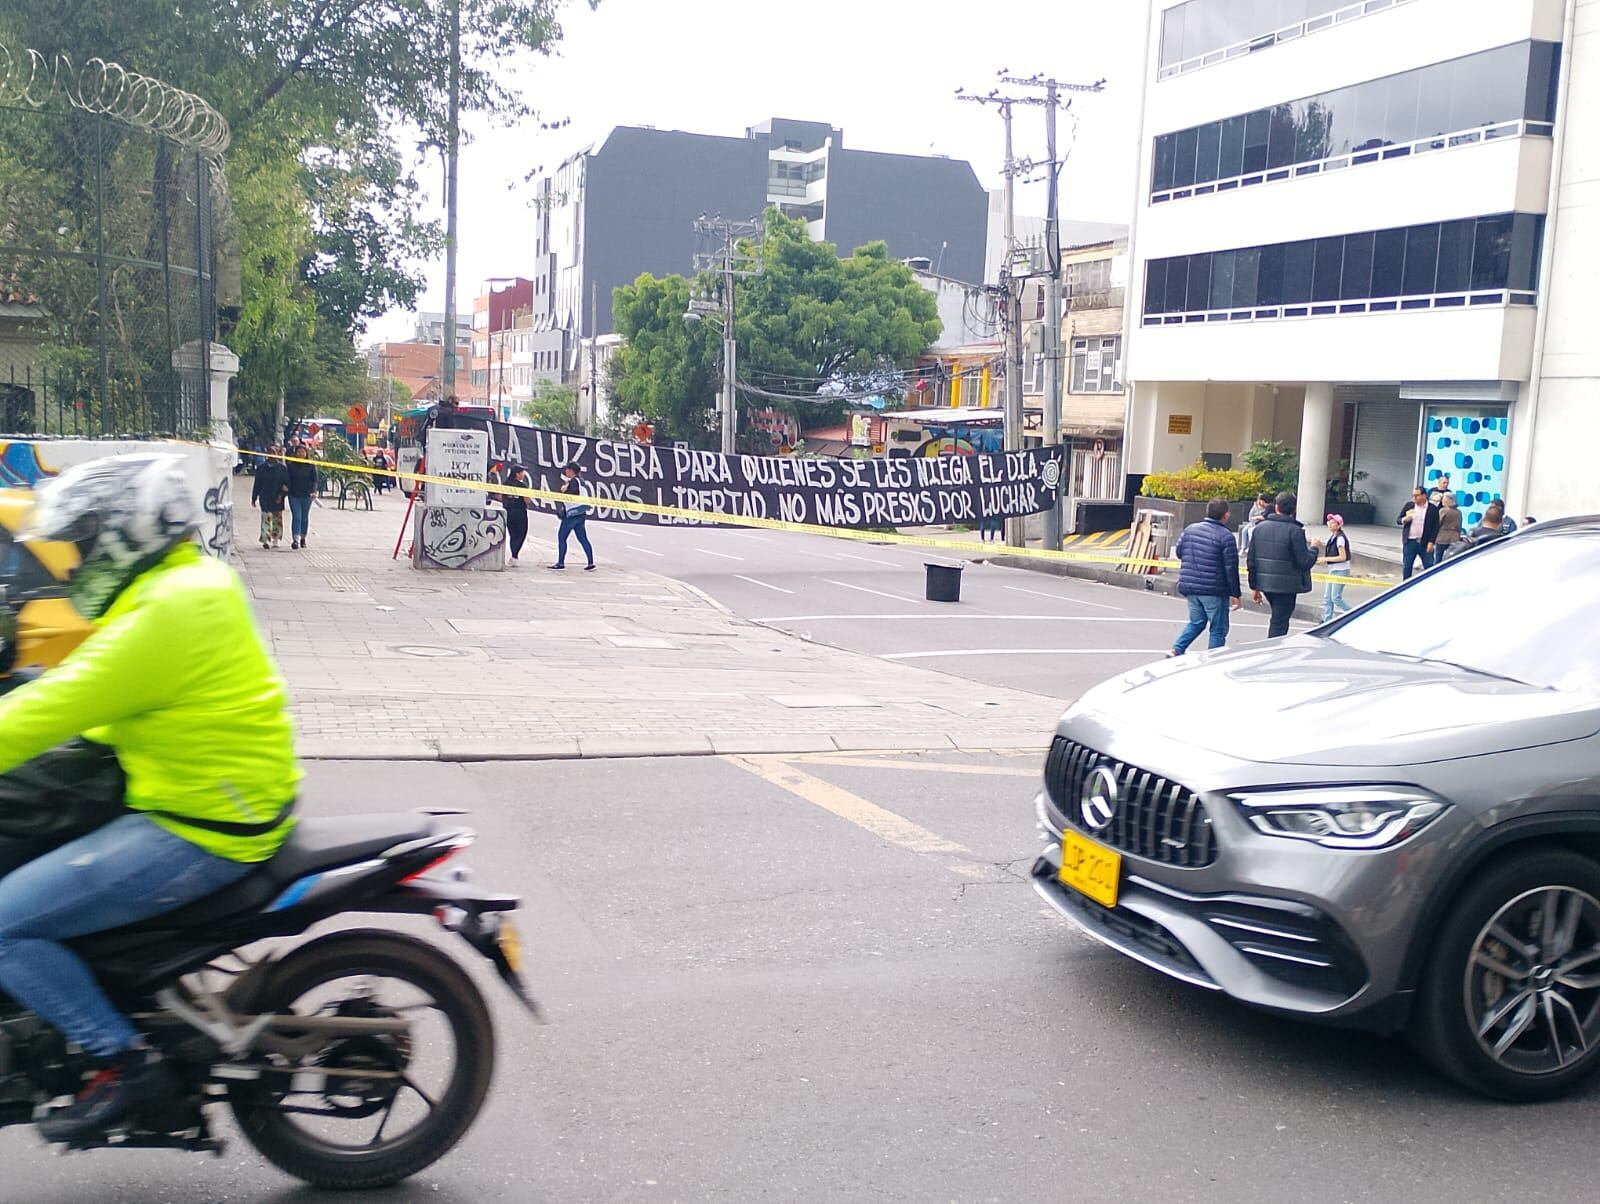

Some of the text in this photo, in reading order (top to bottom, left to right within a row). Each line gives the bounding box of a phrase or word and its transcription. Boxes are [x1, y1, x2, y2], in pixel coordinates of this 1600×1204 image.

[486, 421, 522, 464] LA
[536, 430, 588, 473] LUZ
[595, 440, 664, 480] SERA
[673, 448, 733, 484] PARA
[741, 455, 836, 488] QUIENES
[839, 459, 871, 488] SE
[872, 456, 912, 489] LES
[915, 455, 973, 488] NIEGA
[978, 455, 1004, 483] EL
[778, 493, 807, 523] NO
[815, 488, 862, 525] MÁS
[862, 490, 935, 524] PRESXS
[938, 490, 976, 520] POR
[979, 482, 1040, 518] LUCHAR
